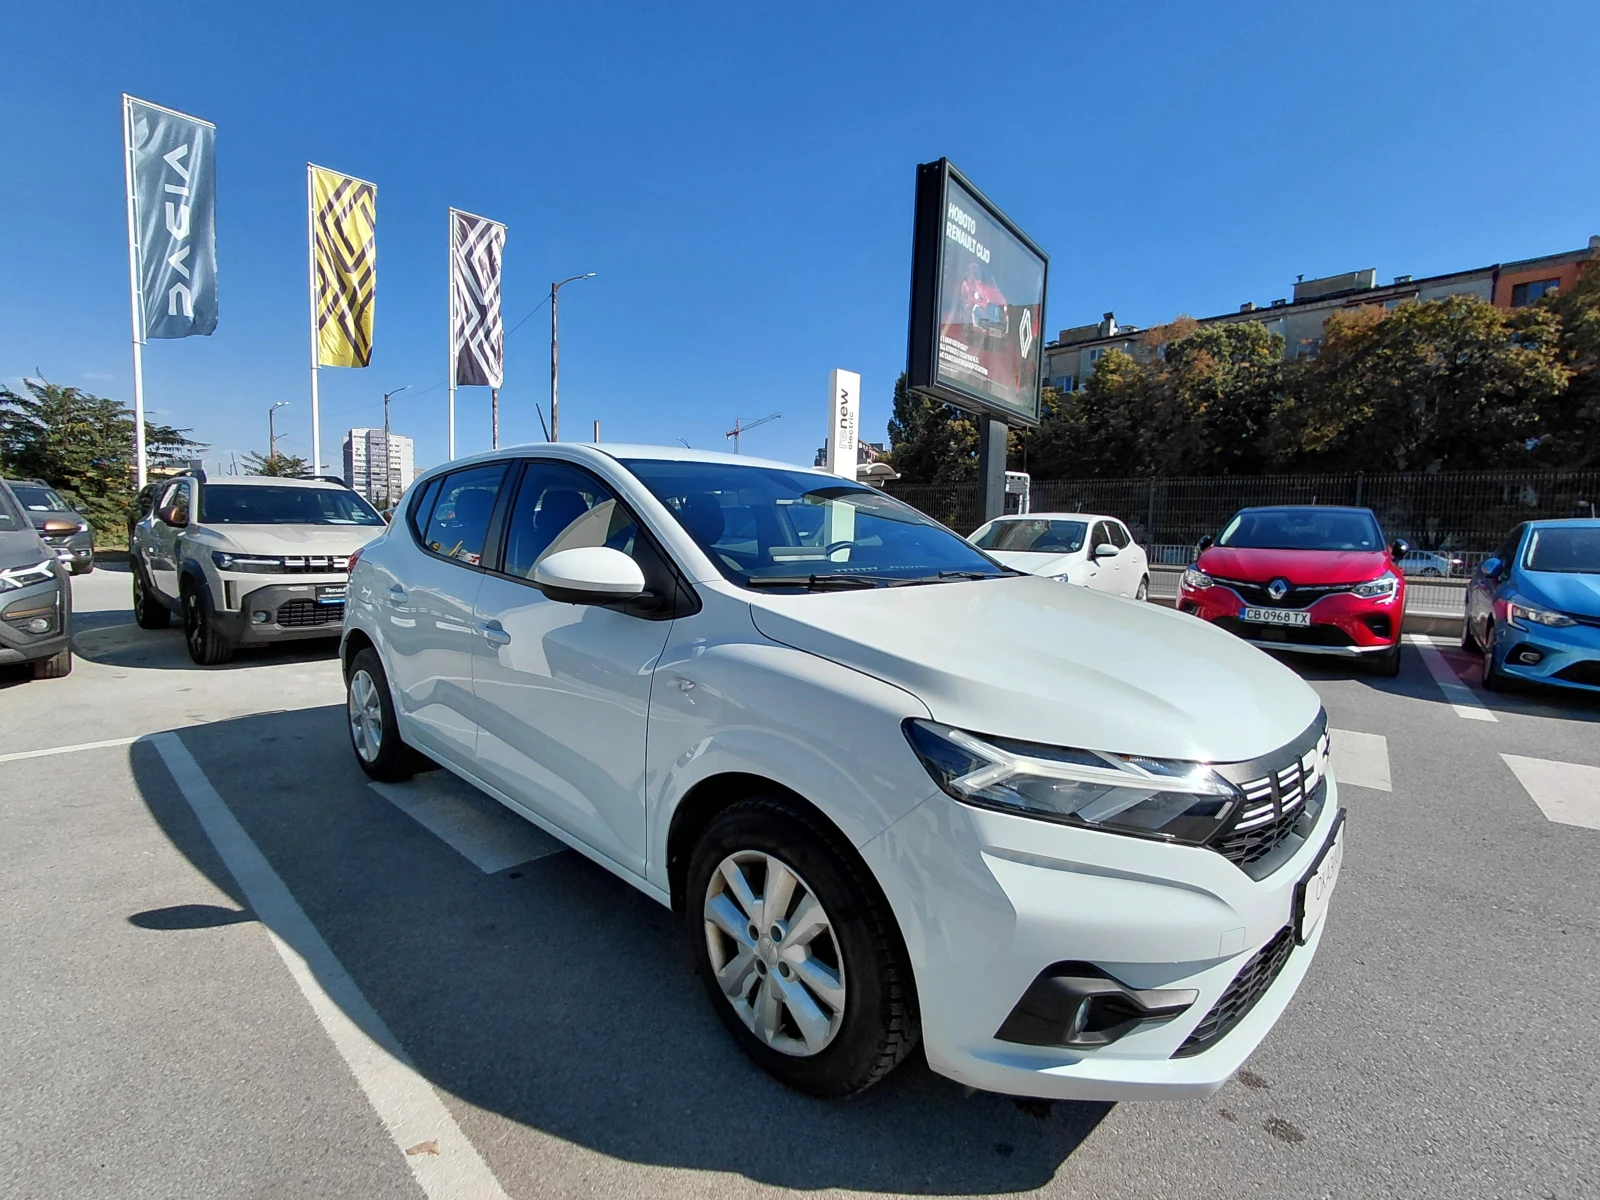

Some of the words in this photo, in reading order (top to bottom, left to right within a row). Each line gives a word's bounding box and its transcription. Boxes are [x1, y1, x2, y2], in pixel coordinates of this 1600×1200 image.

[946, 221, 977, 254] RENAULT
[976, 243, 990, 264] CLIO
[839, 388, 848, 449] renew
[1247, 609, 1261, 620] CB
[1263, 611, 1290, 622] 0968
[1293, 613, 1308, 624] TX
